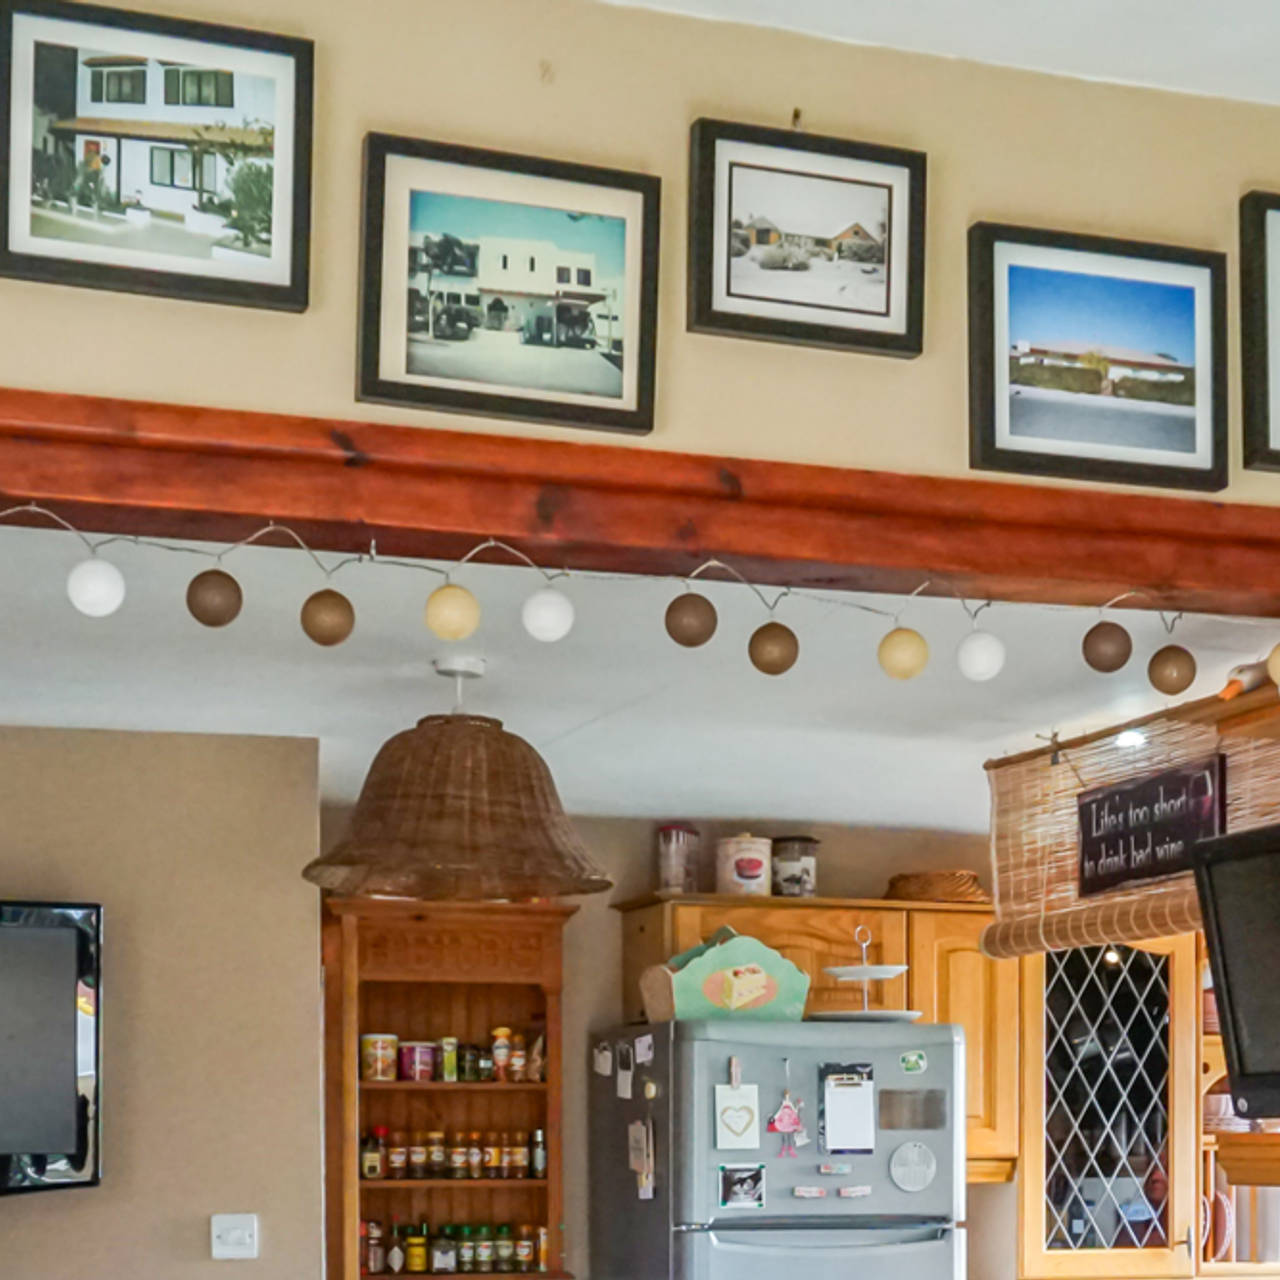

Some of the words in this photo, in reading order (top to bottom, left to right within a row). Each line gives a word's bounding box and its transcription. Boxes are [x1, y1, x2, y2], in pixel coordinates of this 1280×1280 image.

[1129, 801, 1150, 828] too
[1153, 784, 1187, 821] short
[1097, 838, 1128, 876] drink
[1129, 831, 1152, 869] bad
[1155, 835, 1185, 859] wine
